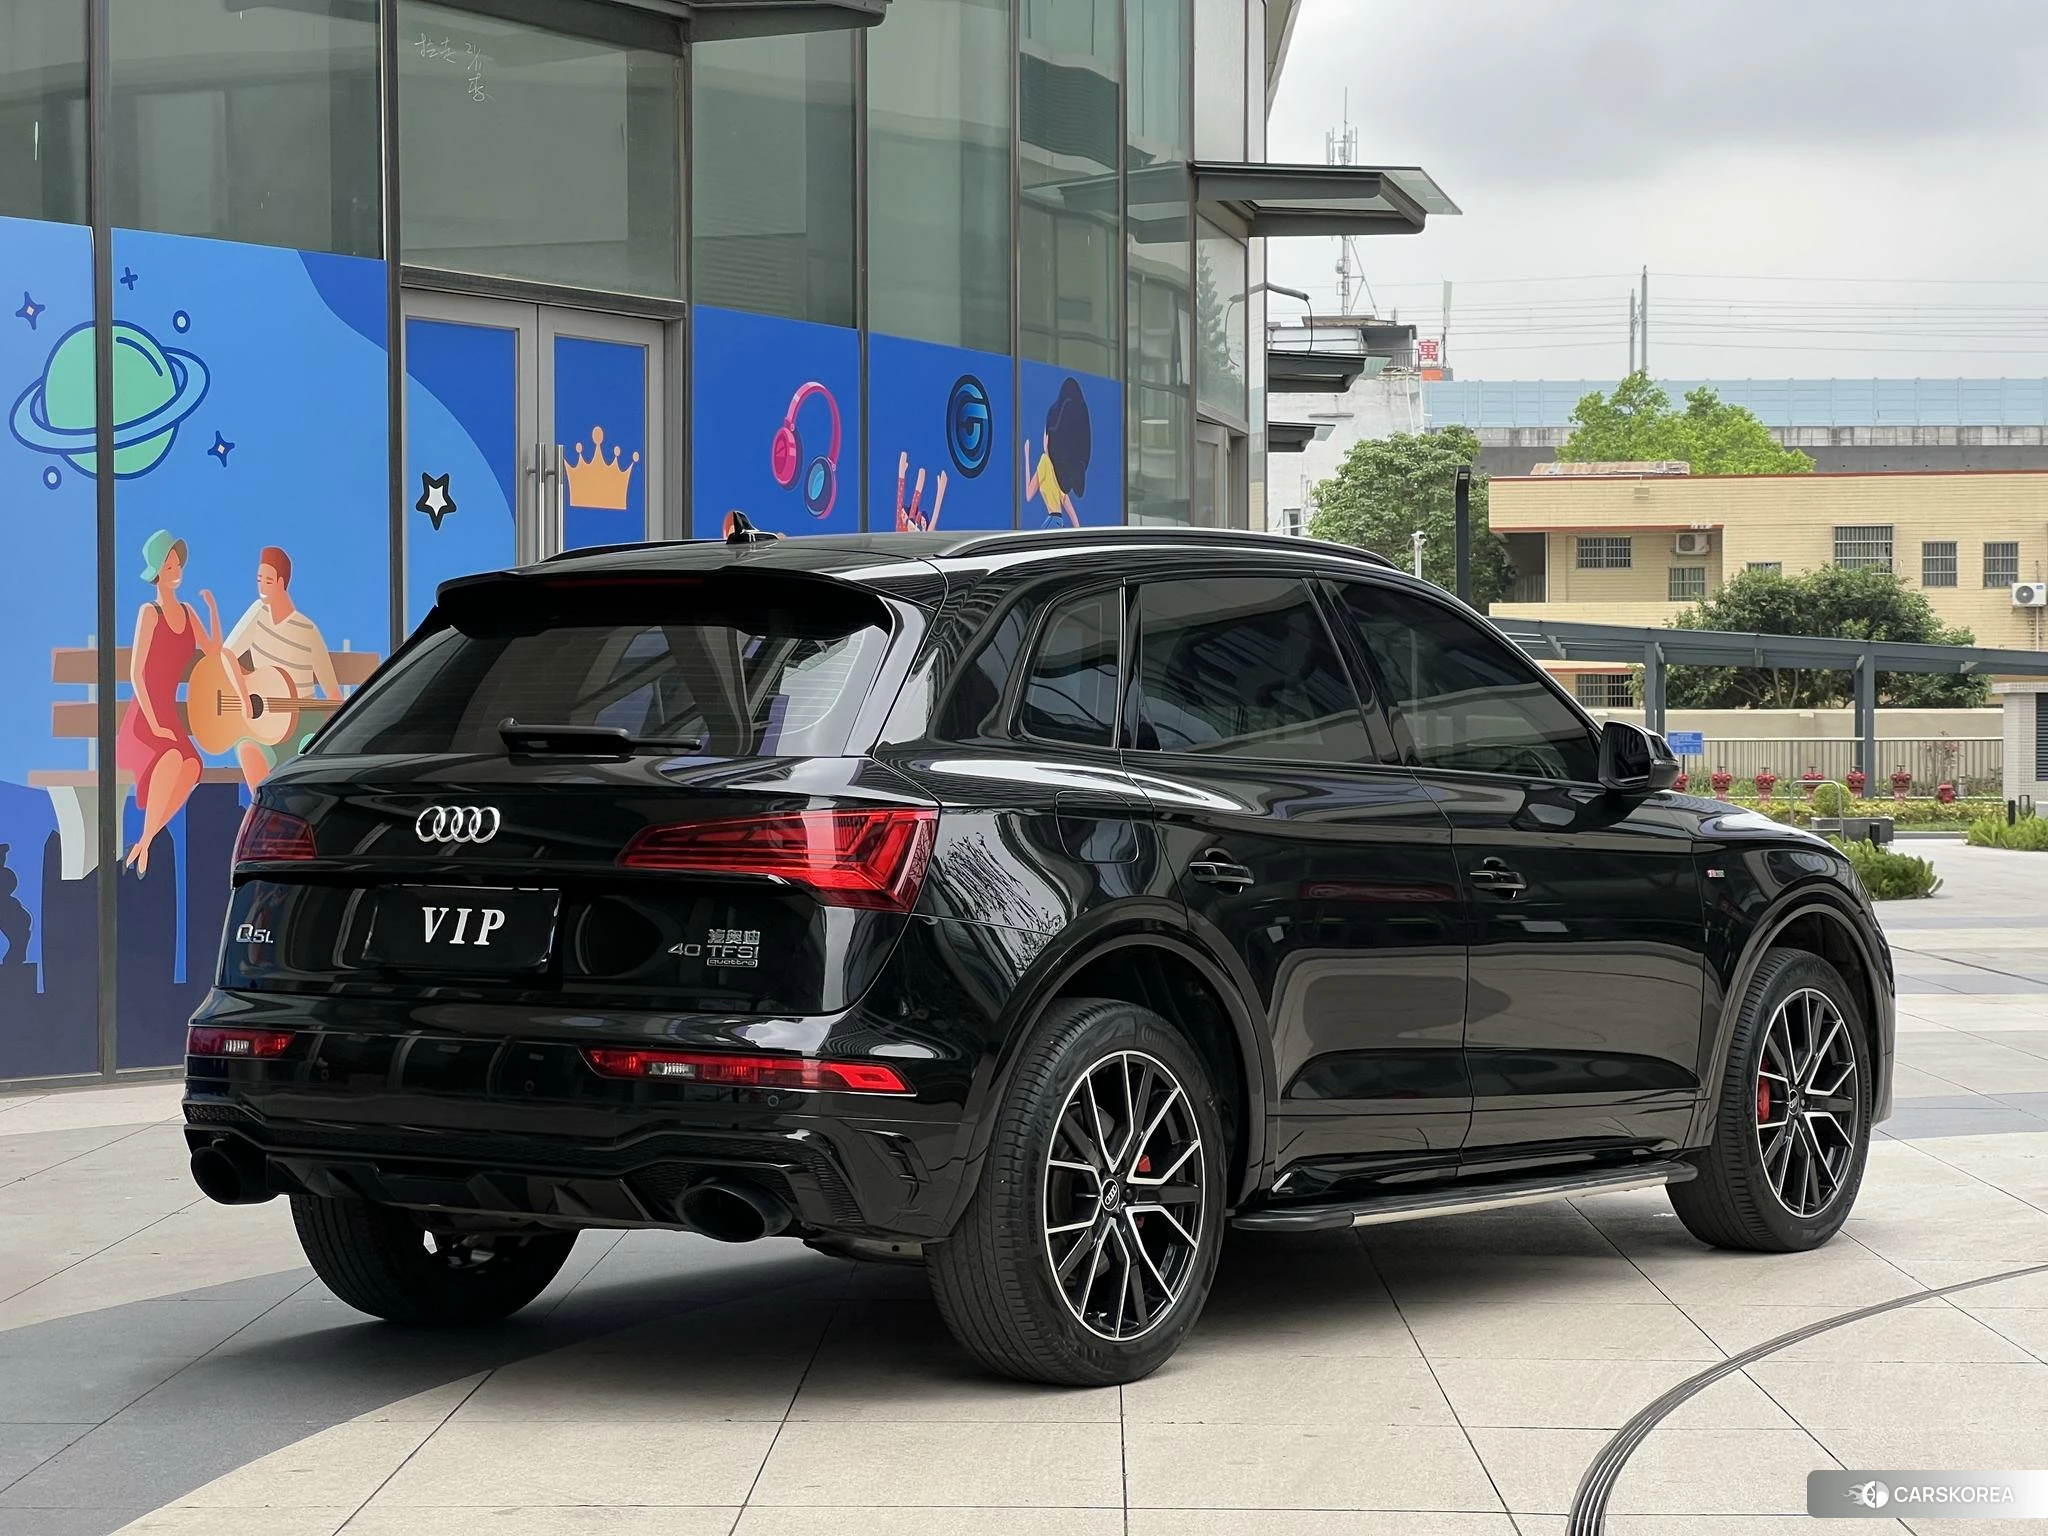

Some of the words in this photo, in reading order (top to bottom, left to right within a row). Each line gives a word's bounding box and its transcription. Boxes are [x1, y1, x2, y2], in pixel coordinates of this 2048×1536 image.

[236, 923, 274, 944] Q5L
[421, 906, 506, 946] VIP
[668, 943, 701, 957] 40
[707, 945, 759, 958] TFSI
[708, 959, 757, 967] quattro
